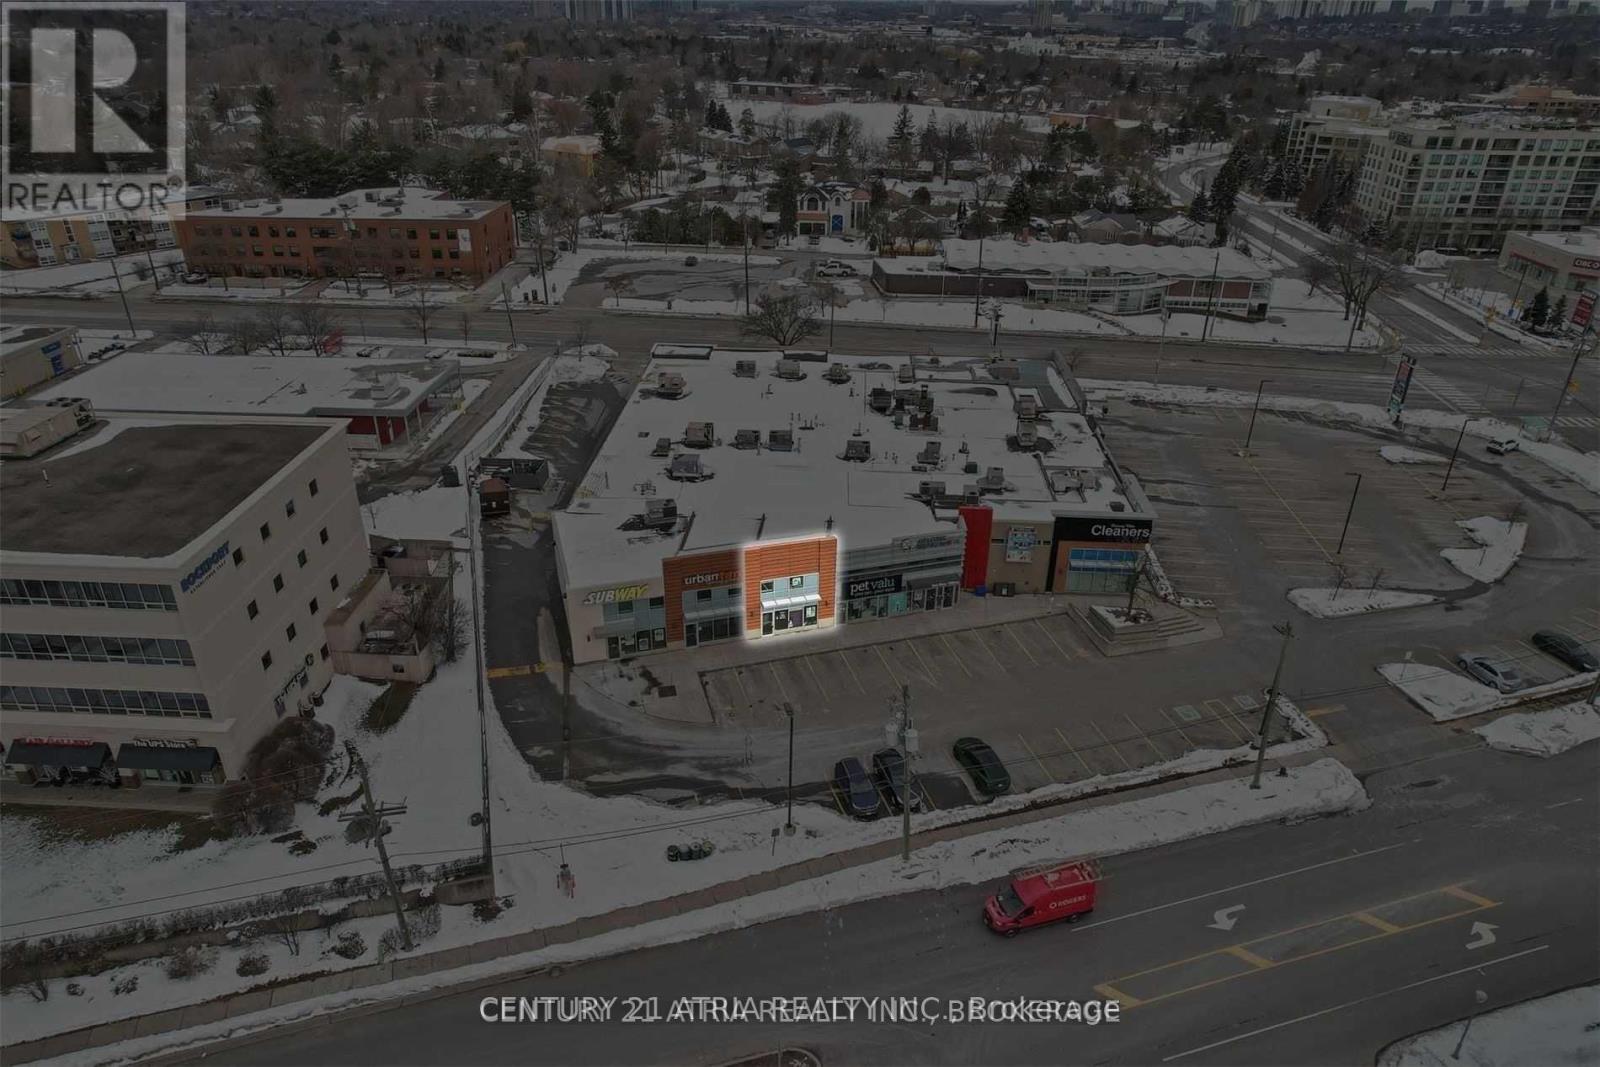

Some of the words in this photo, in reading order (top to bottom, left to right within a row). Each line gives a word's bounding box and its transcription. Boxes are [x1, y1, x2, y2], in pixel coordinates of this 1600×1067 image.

[1090, 523, 1150, 538] Cleaners
[684, 573, 719, 585] urban
[583, 584, 649, 605] SUBWAY
[849, 581, 869, 596] pet
[870, 578, 896, 590] valu
[1057, 895, 1087, 907] ROGERS
